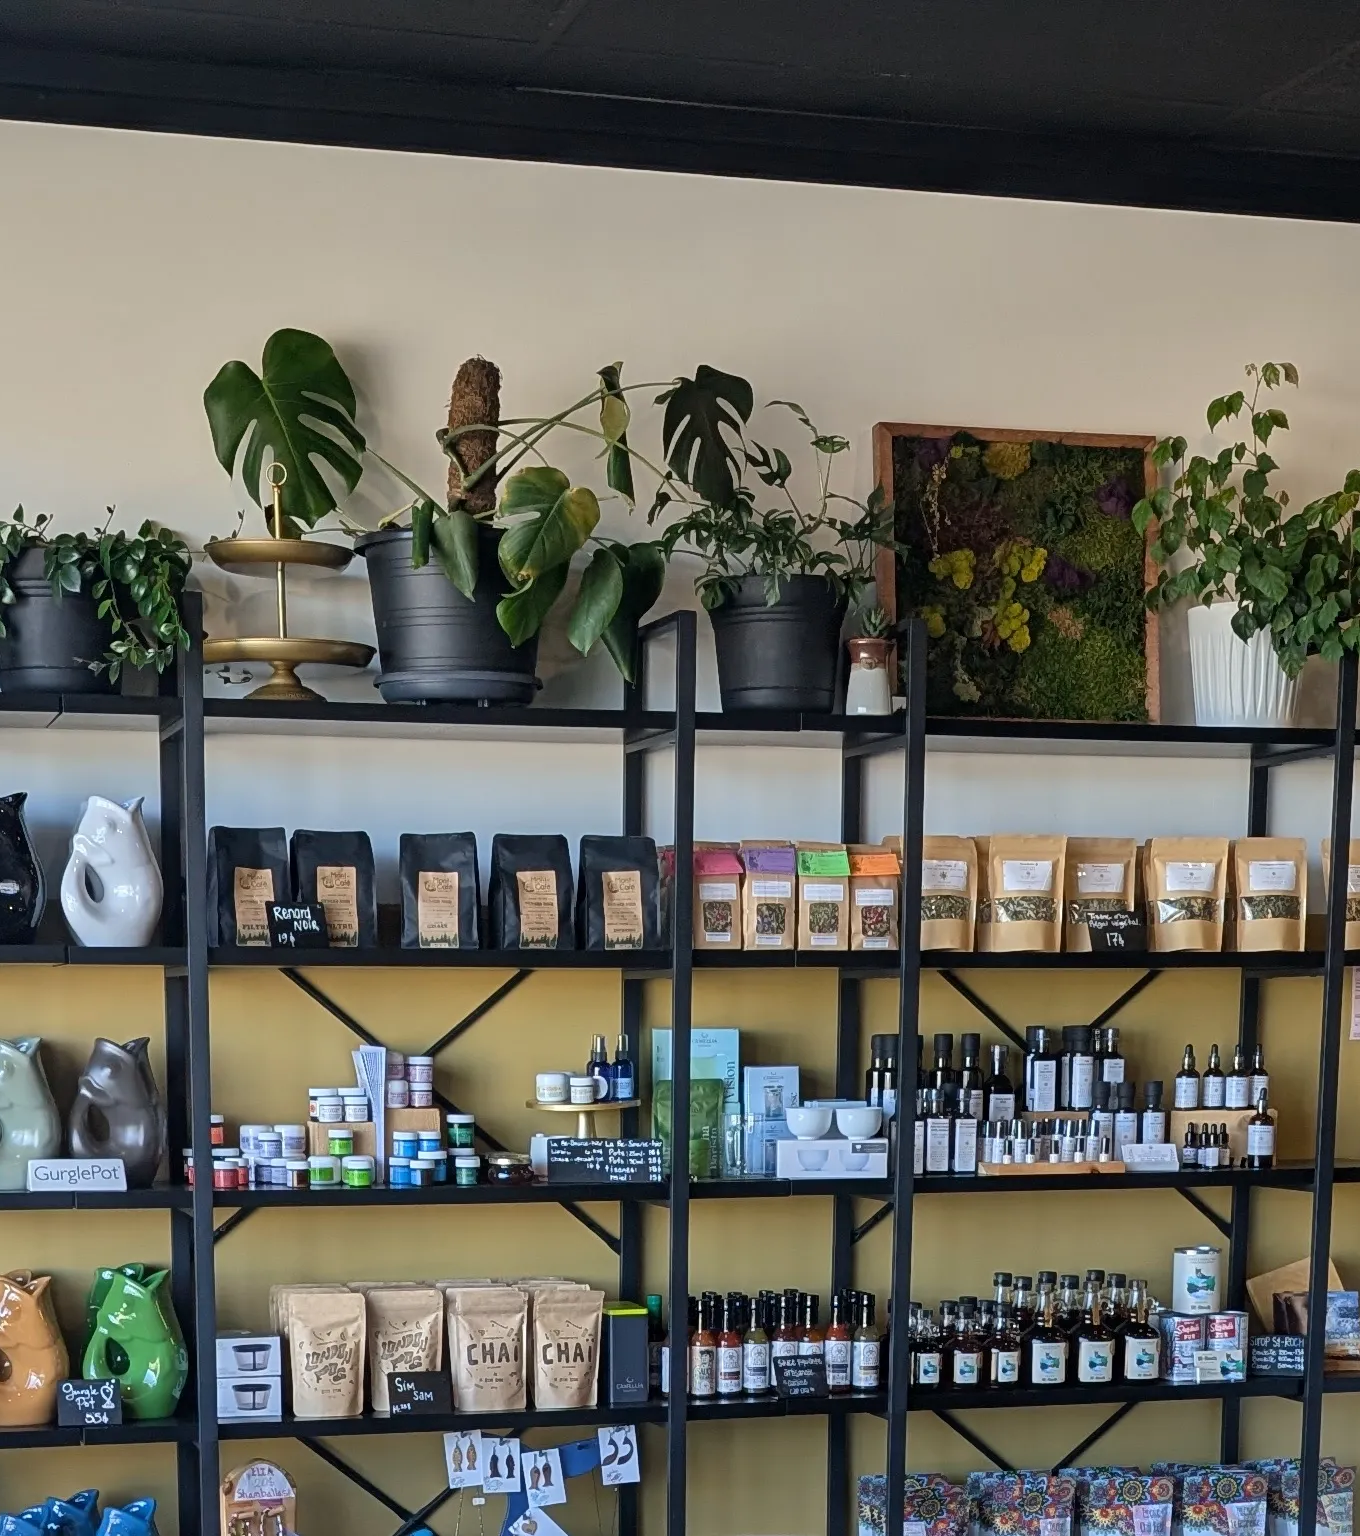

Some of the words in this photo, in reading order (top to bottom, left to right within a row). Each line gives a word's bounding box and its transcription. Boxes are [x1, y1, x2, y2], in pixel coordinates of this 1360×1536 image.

[273, 905, 312, 921] Renard
[34, 1165, 119, 1184] GurglePot
[304, 1343, 353, 1372] LONDON
[380, 1332, 428, 1361] LONDON
[466, 1337, 520, 1366] CHAÏ
[542, 1337, 594, 1366] CHAÏ
[314, 1362, 347, 1384] FOG
[391, 1351, 423, 1372] FOG
